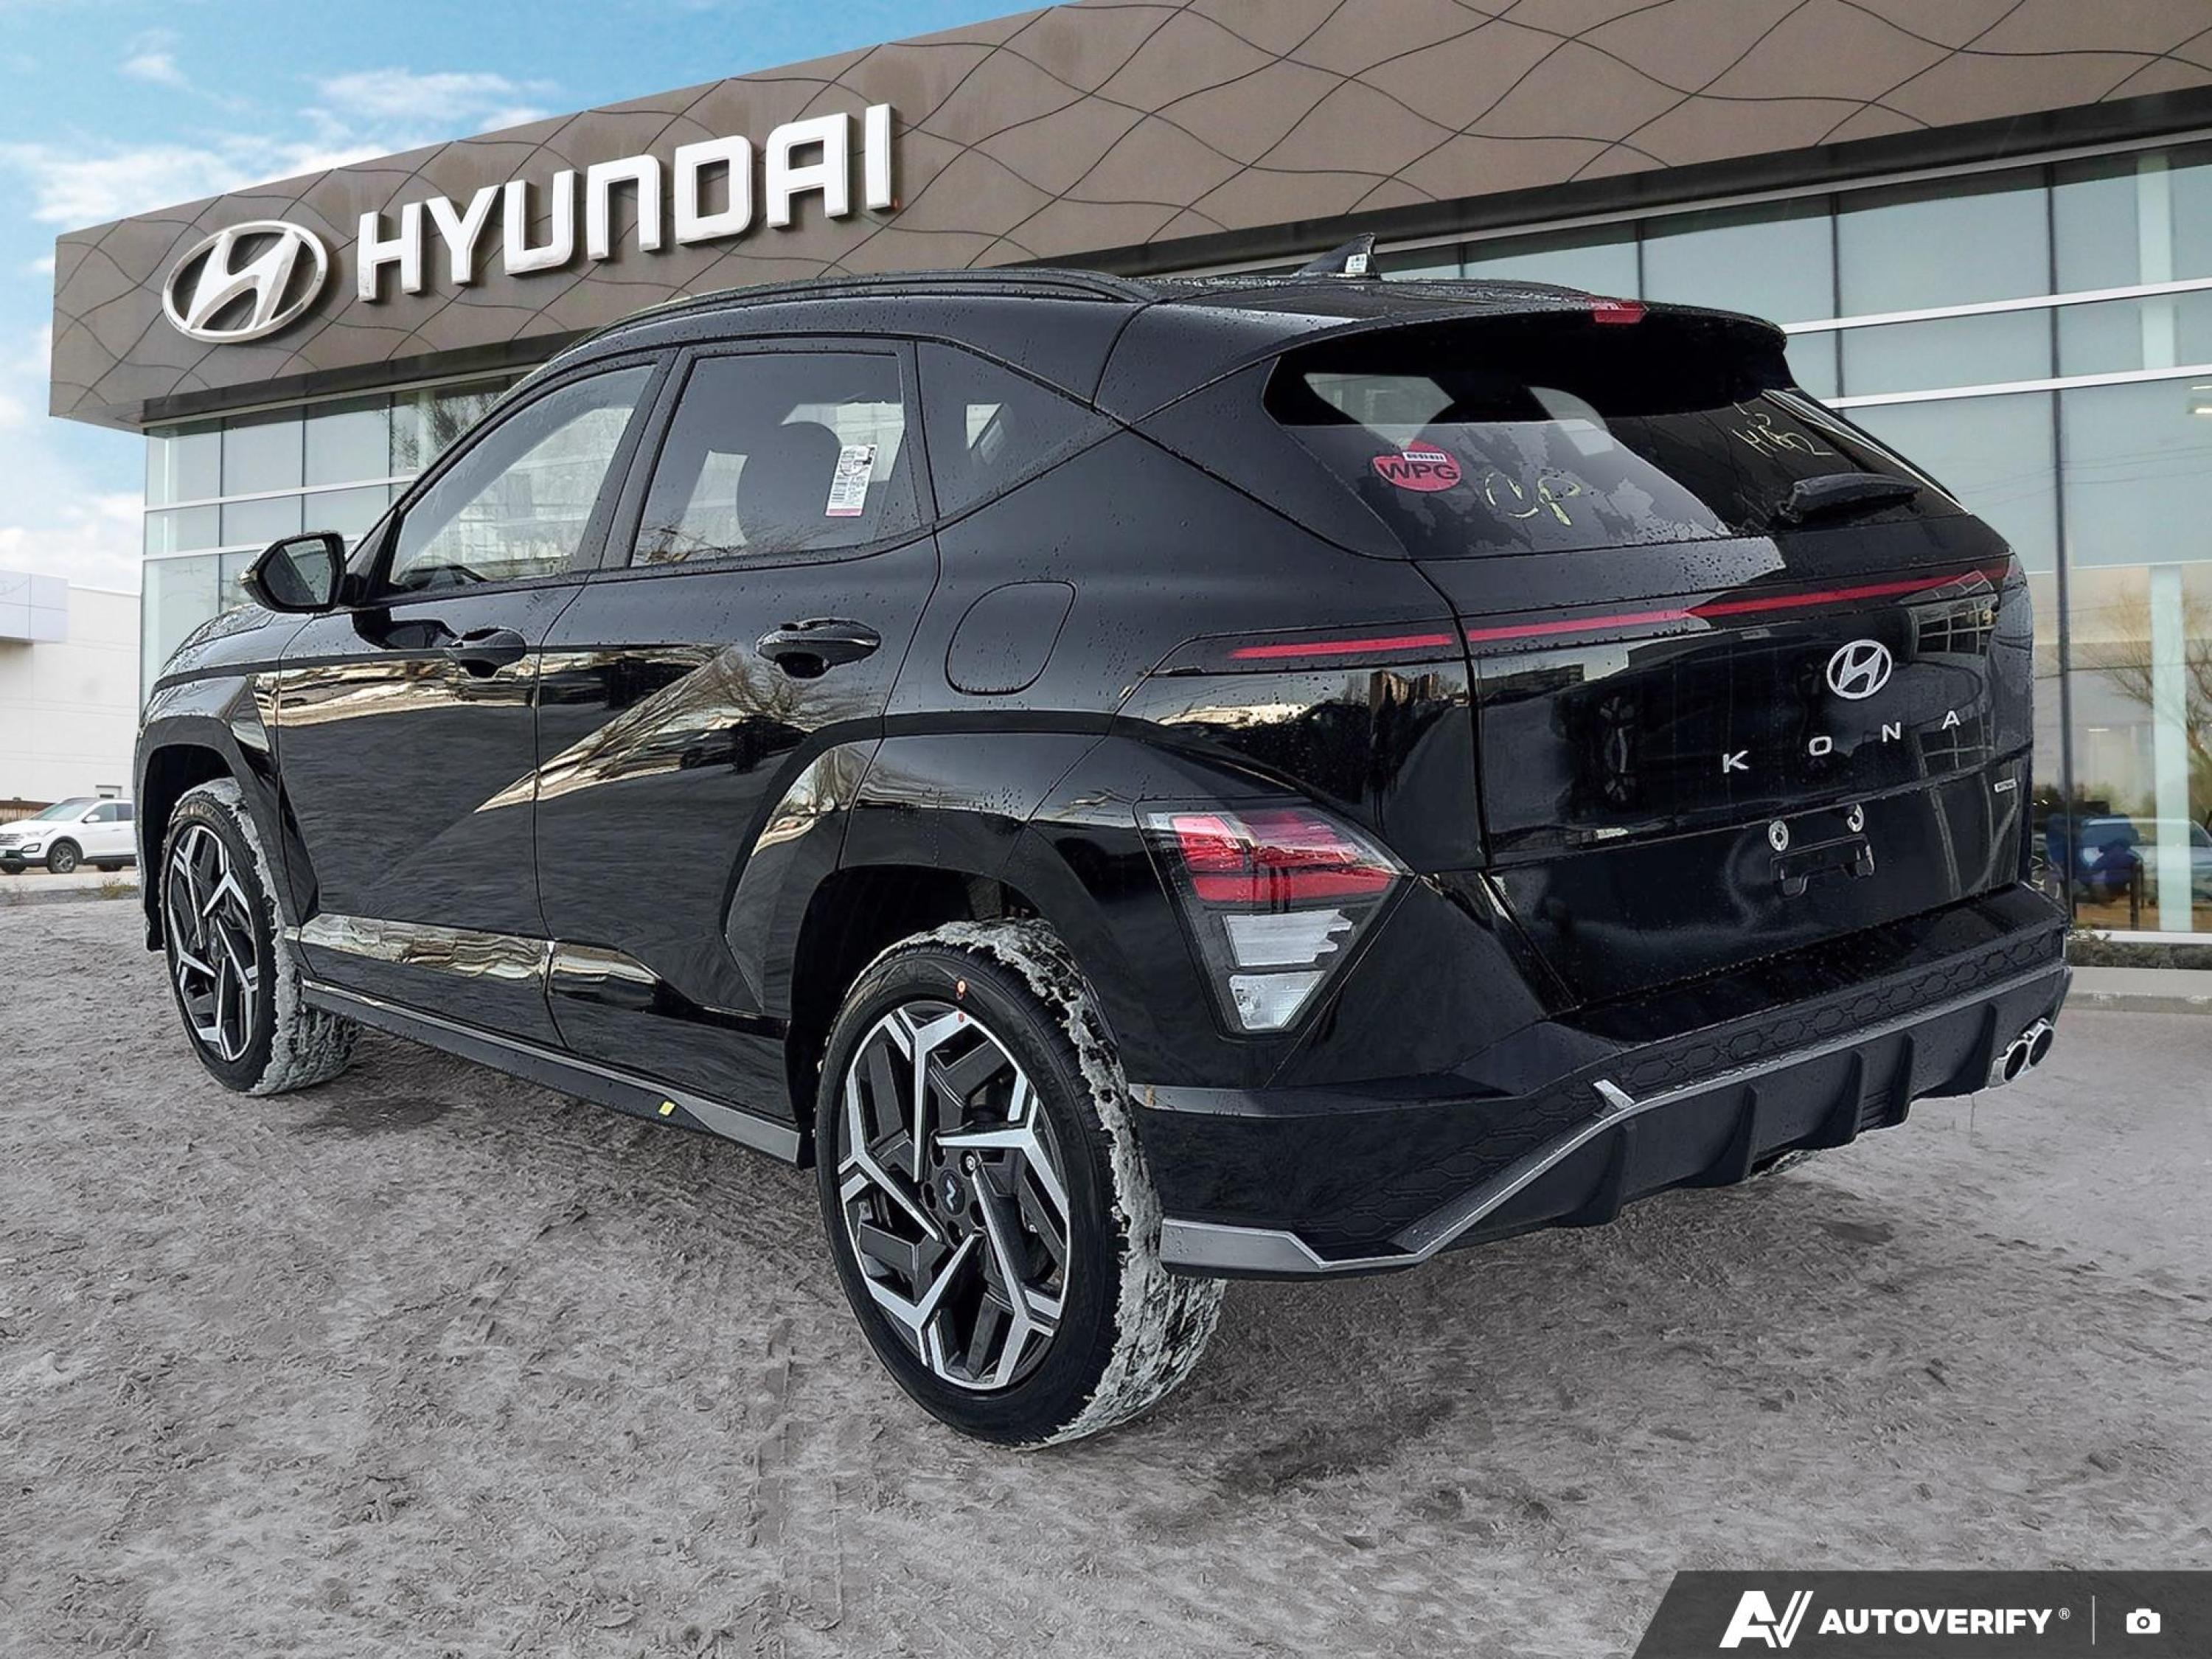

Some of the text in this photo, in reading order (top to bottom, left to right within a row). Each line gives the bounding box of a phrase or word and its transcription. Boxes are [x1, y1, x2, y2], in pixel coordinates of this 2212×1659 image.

[358, 102, 893, 303] HYUNDAI
[1377, 462, 1459, 481] WPG
[1721, 710, 1961, 773] KONA
